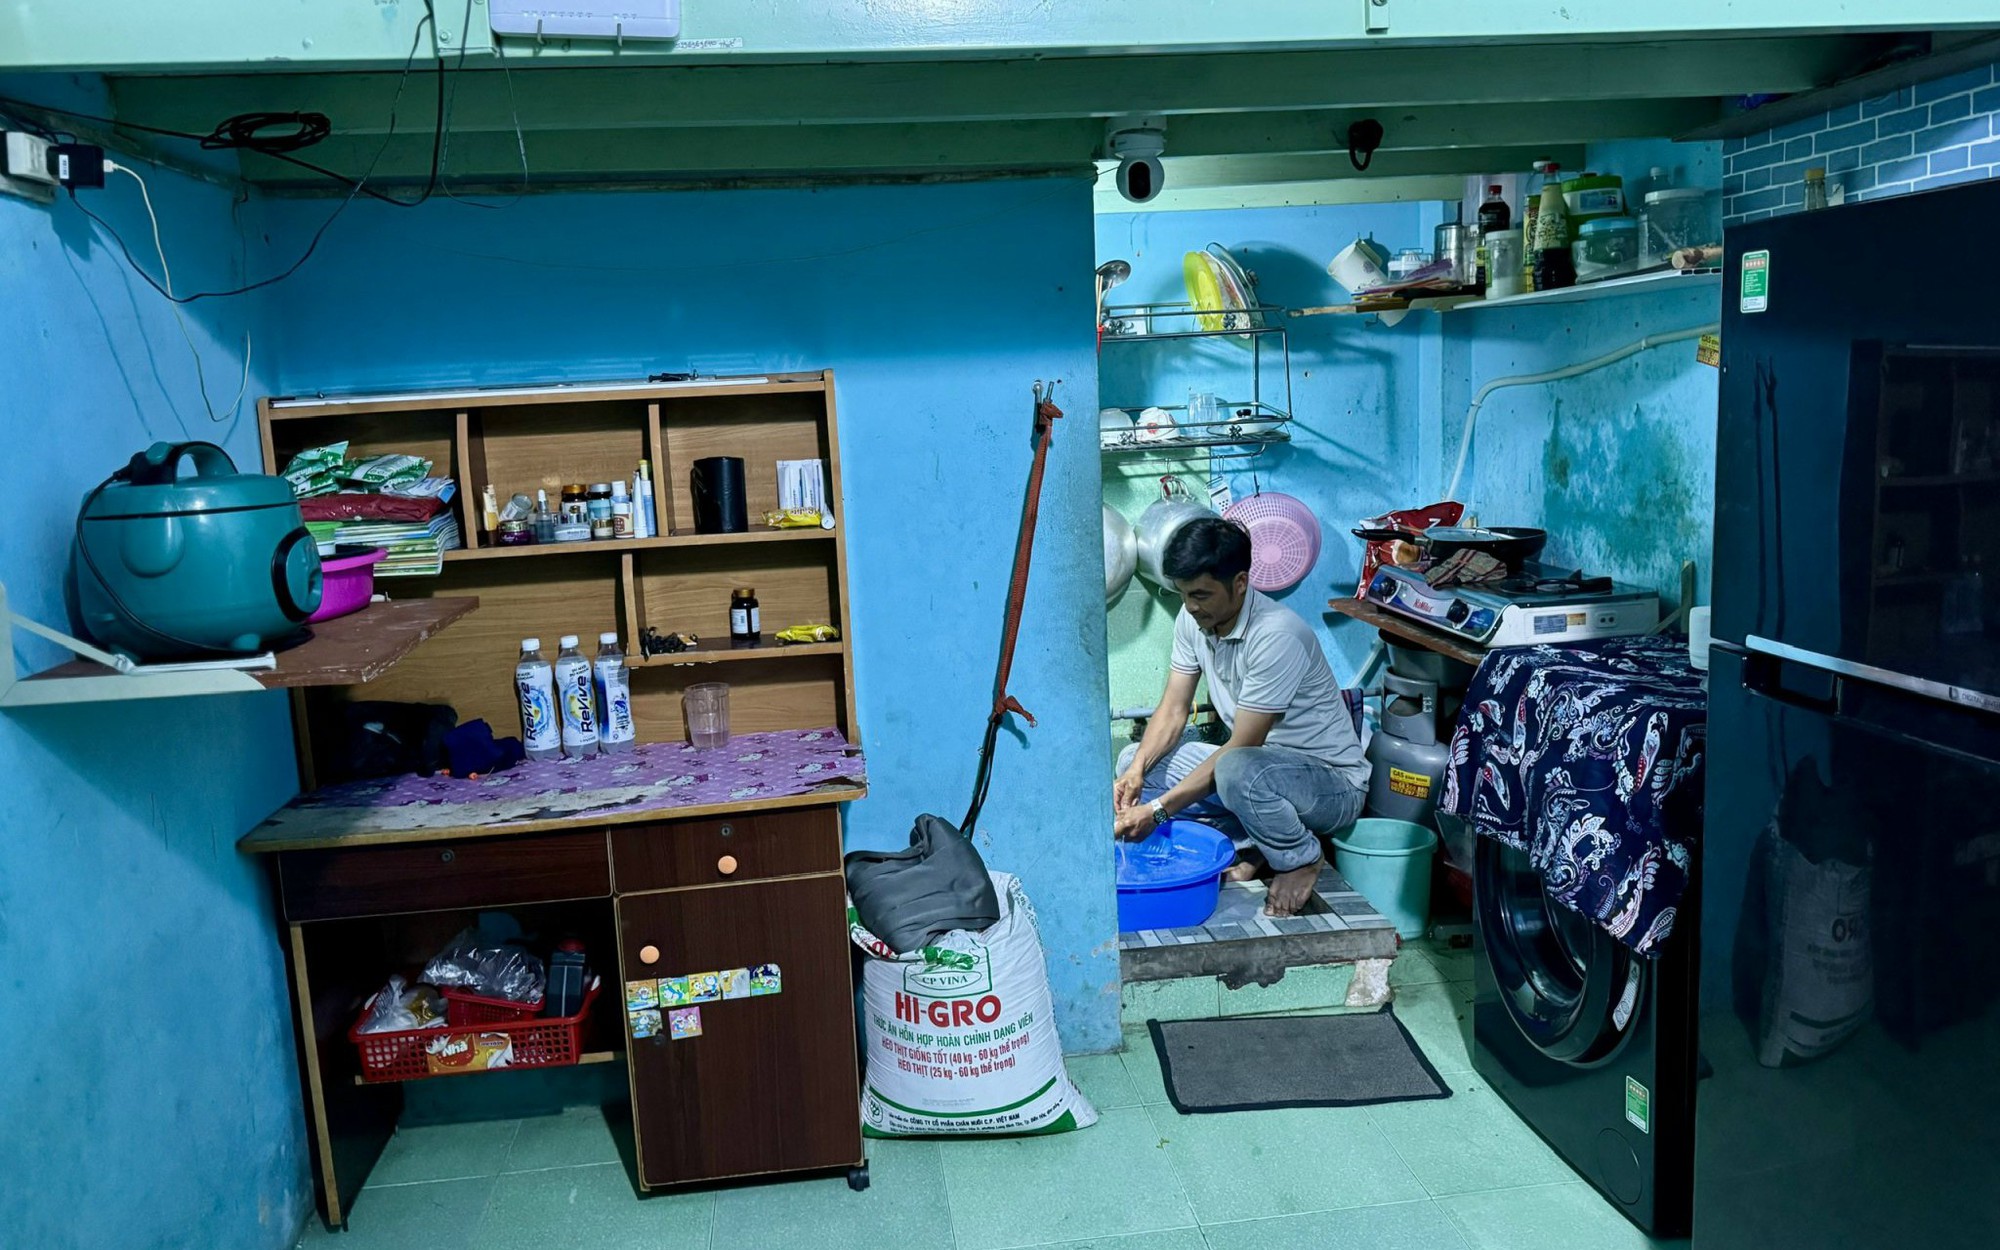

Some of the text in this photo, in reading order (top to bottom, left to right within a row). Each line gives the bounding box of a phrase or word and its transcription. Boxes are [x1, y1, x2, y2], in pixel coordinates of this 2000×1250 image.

[922, 975, 968, 985] CP VINA
[895, 991, 1002, 1028] HI-GRO
[873, 1011, 1034, 1047] THỨC ĂN HỖN HỢP HOÀN CHỈNH DẠNG VIÊN
[881, 1035, 893, 1051] HEO
[894, 1042, 908, 1058] THỊT
[908, 1046, 932, 1063] GIỐNG
[933, 1048, 947, 1064] TỐT
[950, 1053, 962, 1067] (40
[963, 1052, 972, 1065] kg
[978, 1048, 988, 1061] 60
[989, 1047, 998, 1059] kg
[999, 1038, 1011, 1055] thể
[1011, 1031, 1030, 1050] trọng)
[897, 1058, 911, 1073] HEO
[912, 1062, 928, 1078] THỊT
[930, 1066, 942, 1079] (25
[943, 1067, 953, 1080] kg
[959, 1066, 969, 1078] 60
[970, 1065, 979, 1078] kg
[980, 1058, 993, 1074] thể
[994, 1053, 1016, 1072] trọng)
